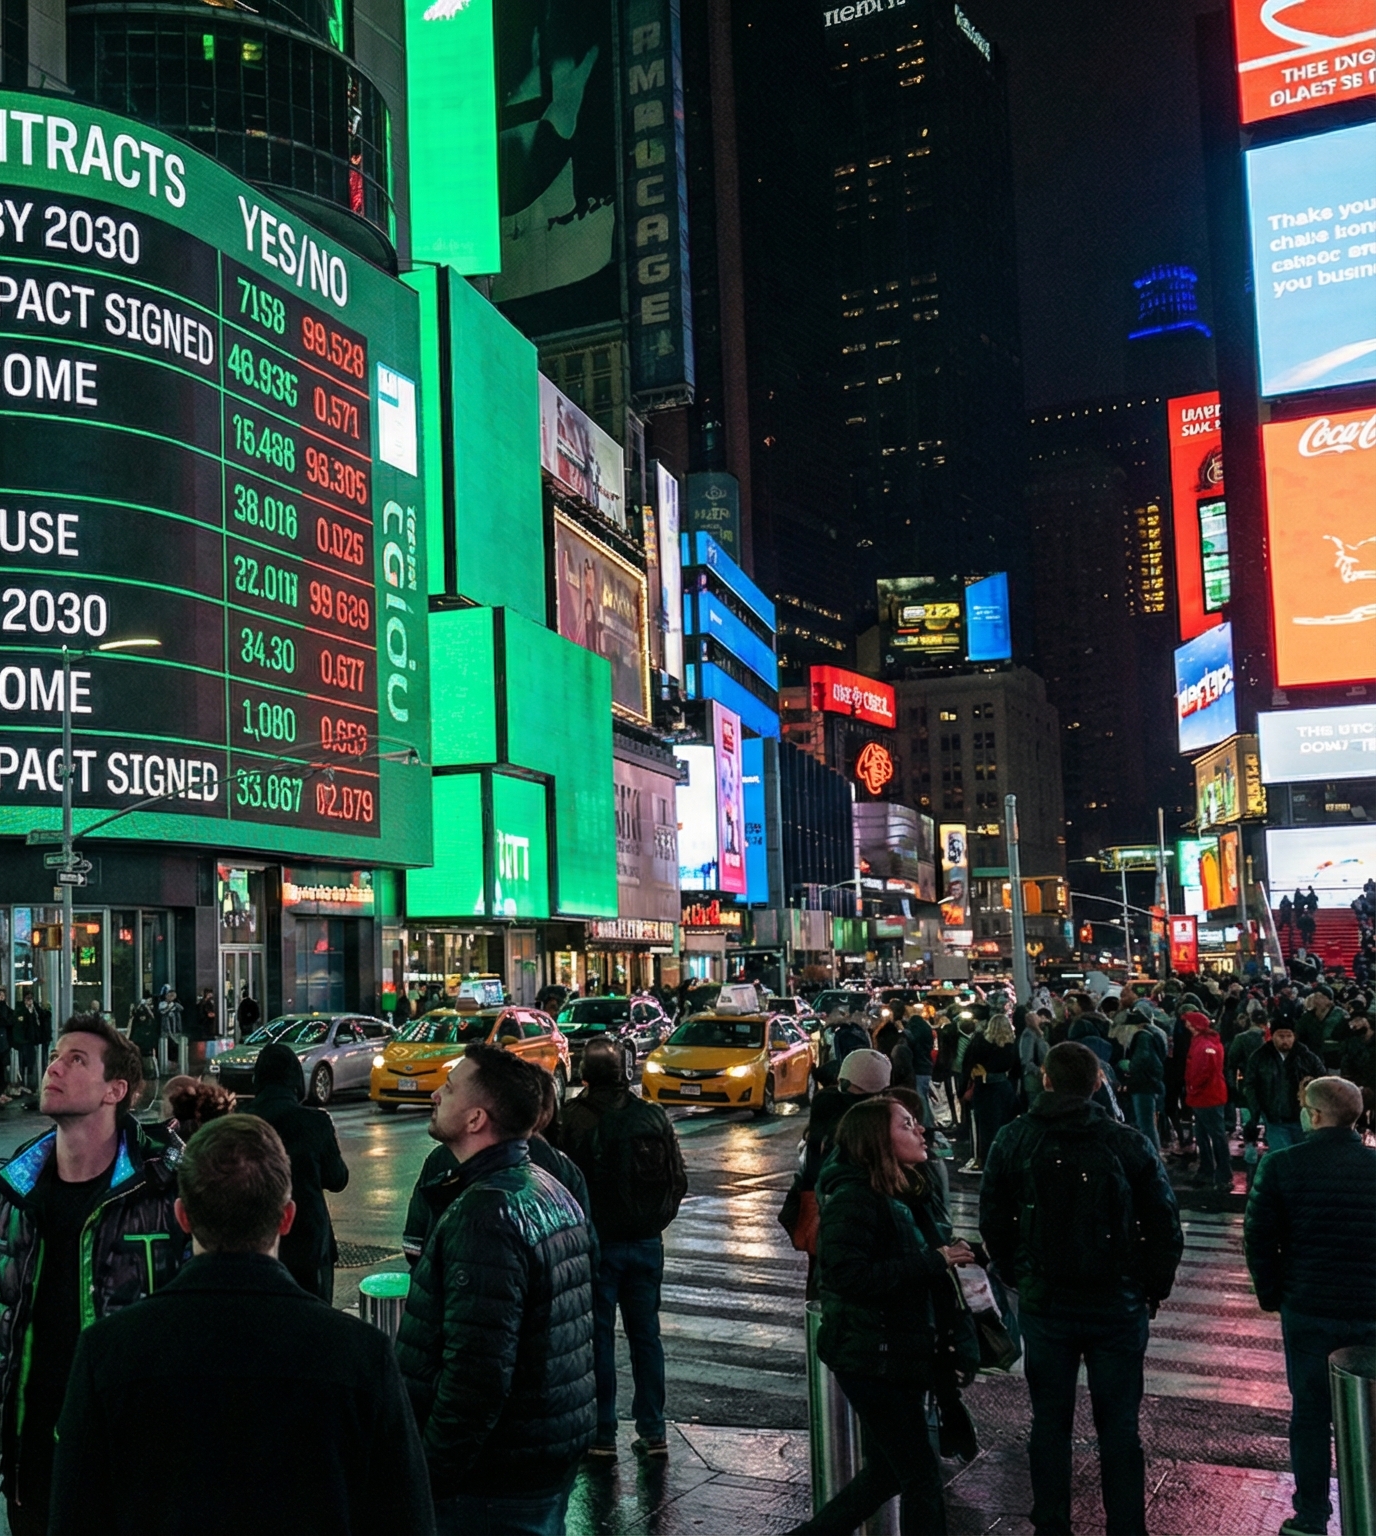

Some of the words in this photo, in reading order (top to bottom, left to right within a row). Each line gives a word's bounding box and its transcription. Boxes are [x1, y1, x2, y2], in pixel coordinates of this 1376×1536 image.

[44, 205, 140, 265] 2030
[238, 195, 348, 308] YES/NO
[1273, 275, 1313, 299] you
[105, 292, 214, 366] SIGNED
[236, 276, 286, 335] 7158
[302, 316, 365, 379] 99.528
[2, 588, 107, 637] 2030
[106, 751, 219, 802] SIGNED
